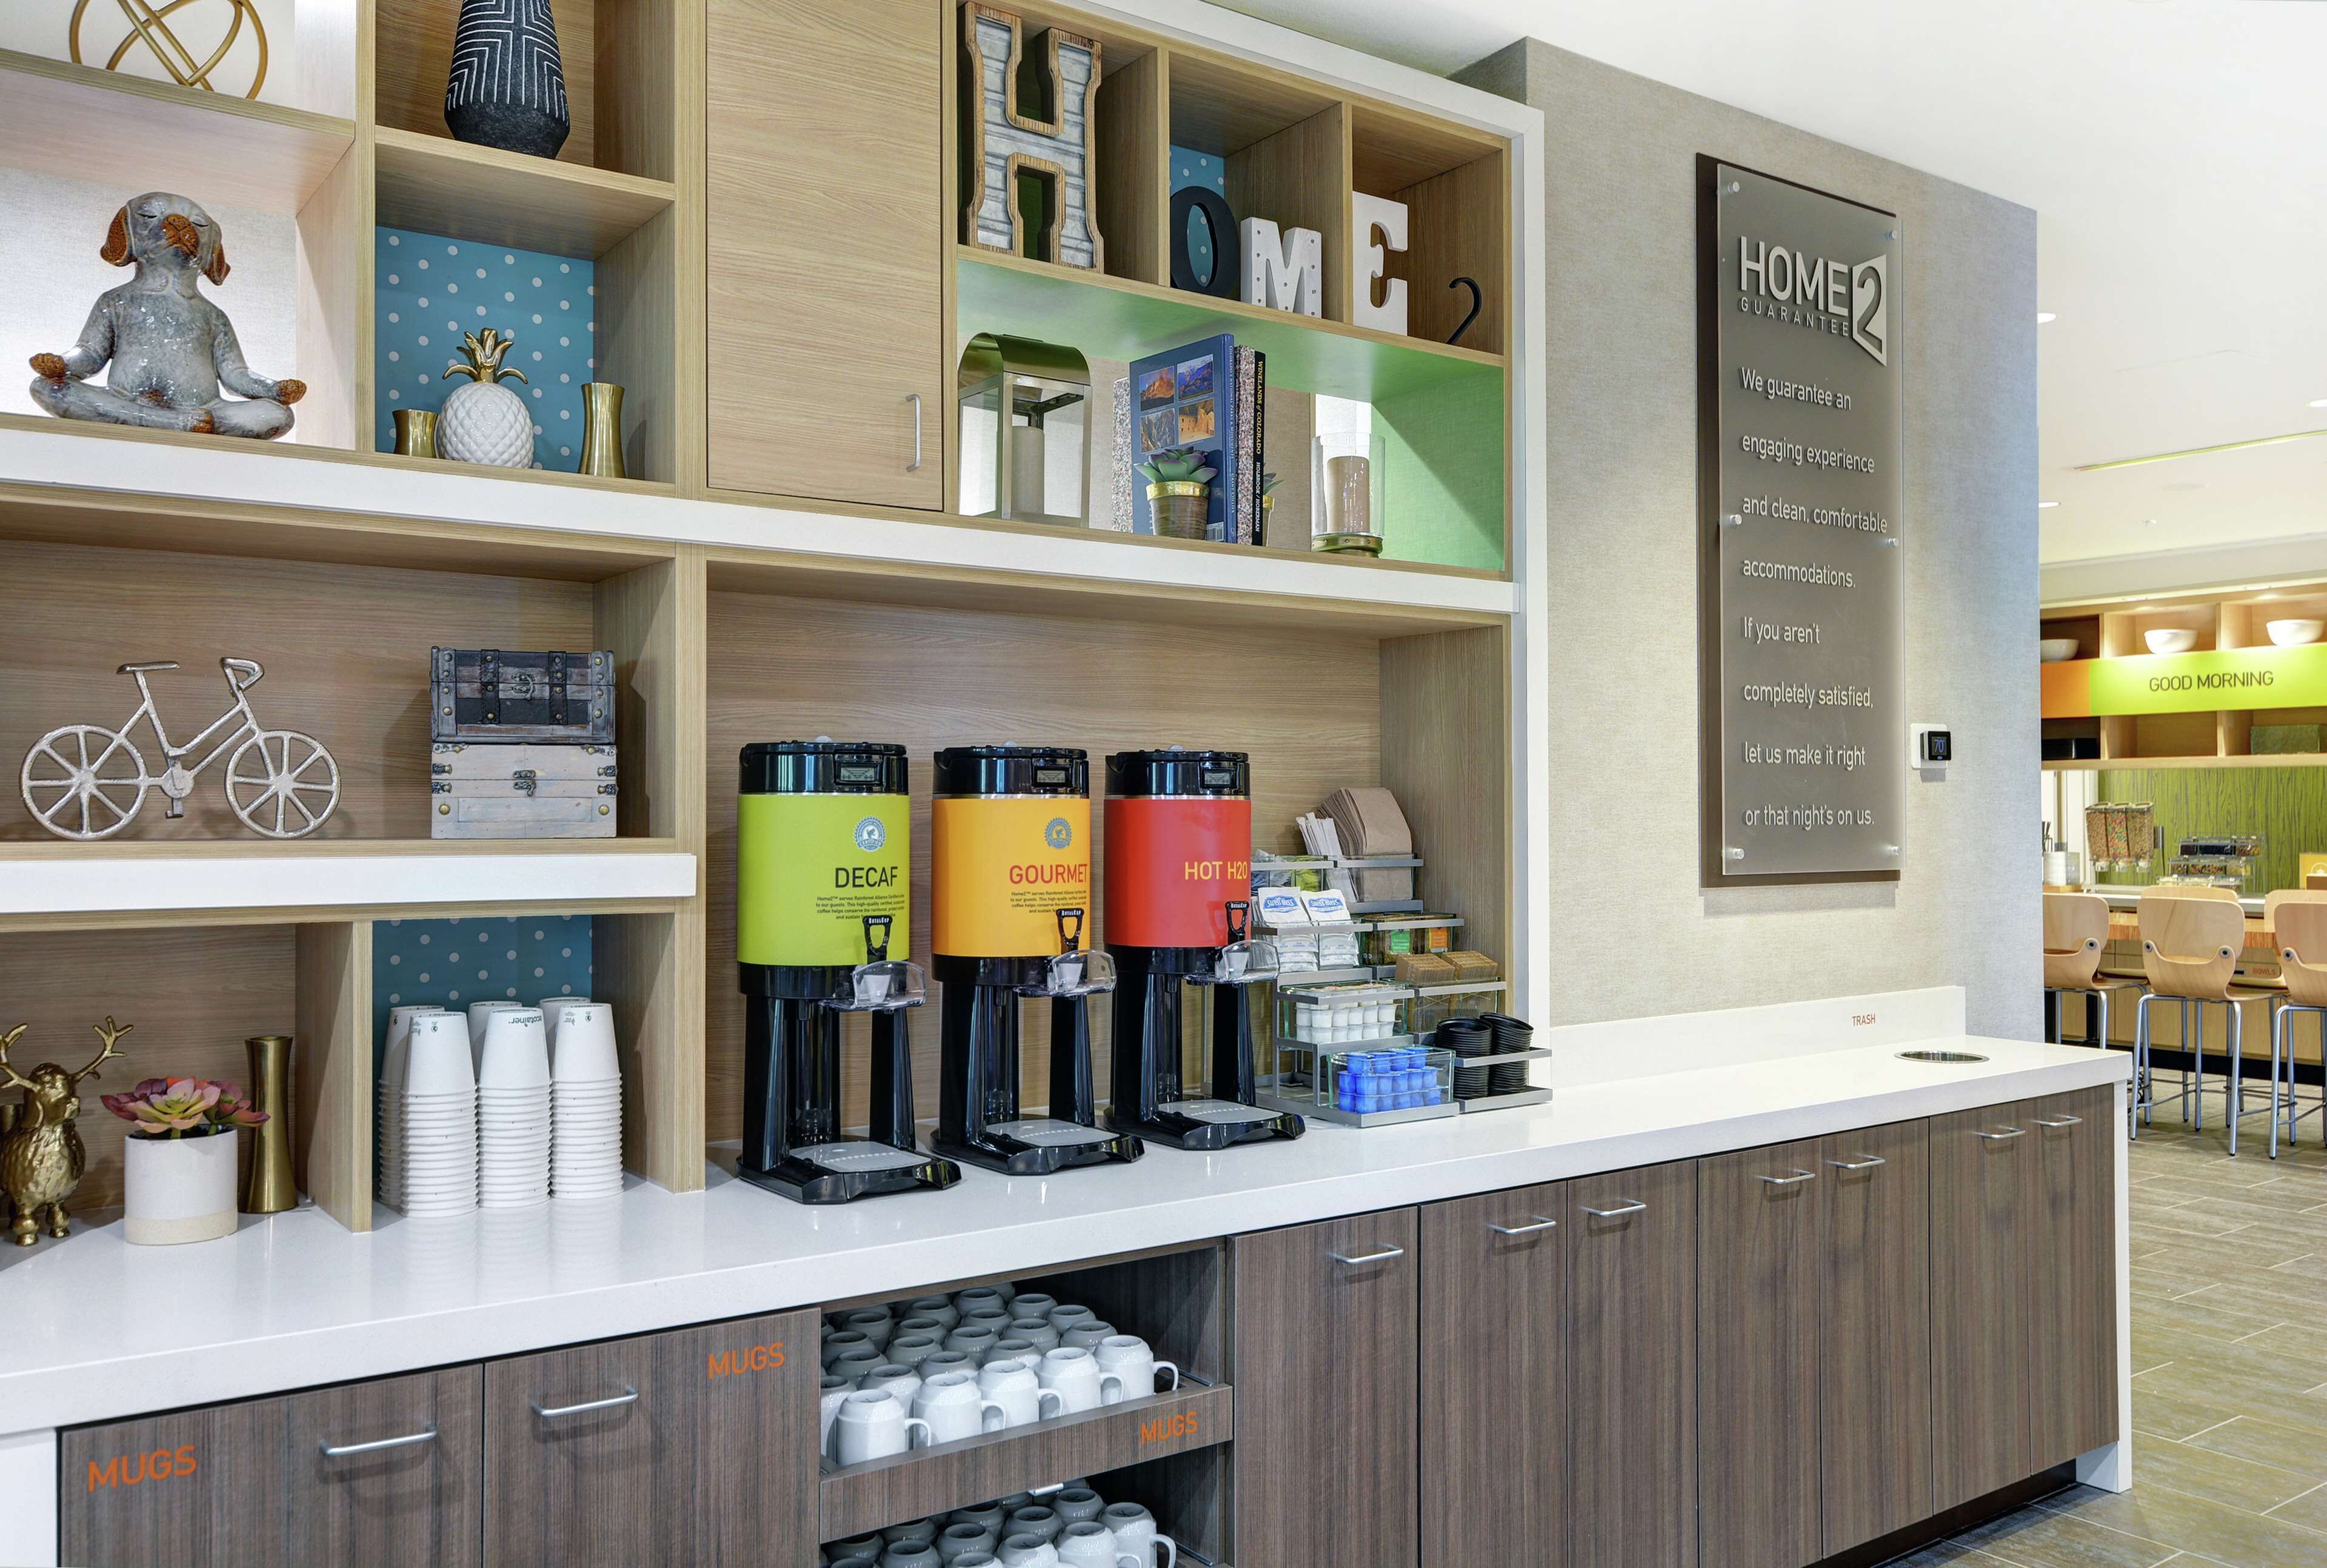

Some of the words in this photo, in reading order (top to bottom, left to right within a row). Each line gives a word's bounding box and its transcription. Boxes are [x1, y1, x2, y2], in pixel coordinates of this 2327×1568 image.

[1740, 296, 1849, 337] GUARANTEE
[1741, 367, 1763, 392] We
[1766, 377, 1832, 406] guarantee
[1835, 392, 1852, 410] an
[1742, 435, 1802, 466] engaging
[1806, 447, 1875, 473] experience
[1742, 495, 1768, 516] and
[1771, 497, 1810, 524] clean,
[1812, 507, 1888, 533] comfortable
[1743, 559, 1856, 589] accommodations.
[1743, 616, 1753, 638] If
[1755, 624, 1780, 644] you
[1783, 623, 1820, 644] aren't
[1744, 681, 1815, 709] completely
[2149, 675, 2192, 692] GOOD
[2197, 670, 2274, 690] MORNING
[1744, 741, 1761, 764] let
[1766, 746, 1781, 764] us
[1786, 744, 1821, 765] make
[1825, 744, 1834, 765] it
[1836, 745, 1866, 771] right
[1745, 809, 1760, 826] or
[1763, 804, 1789, 826] that
[1792, 804, 1833, 831] night's
[1837, 809, 1852, 826] on
[1856, 809, 1875, 826] us.
[835, 866, 898, 889] DECAF
[1009, 863, 1088, 884] GOURMET
[1184, 861, 1223, 880] HOT
[1852, 1013, 1876, 1027] TRASH
[708, 1341, 786, 1381] MUGS
[1140, 1410, 1199, 1446] MUGS
[87, 1445, 198, 1493] MUGS
